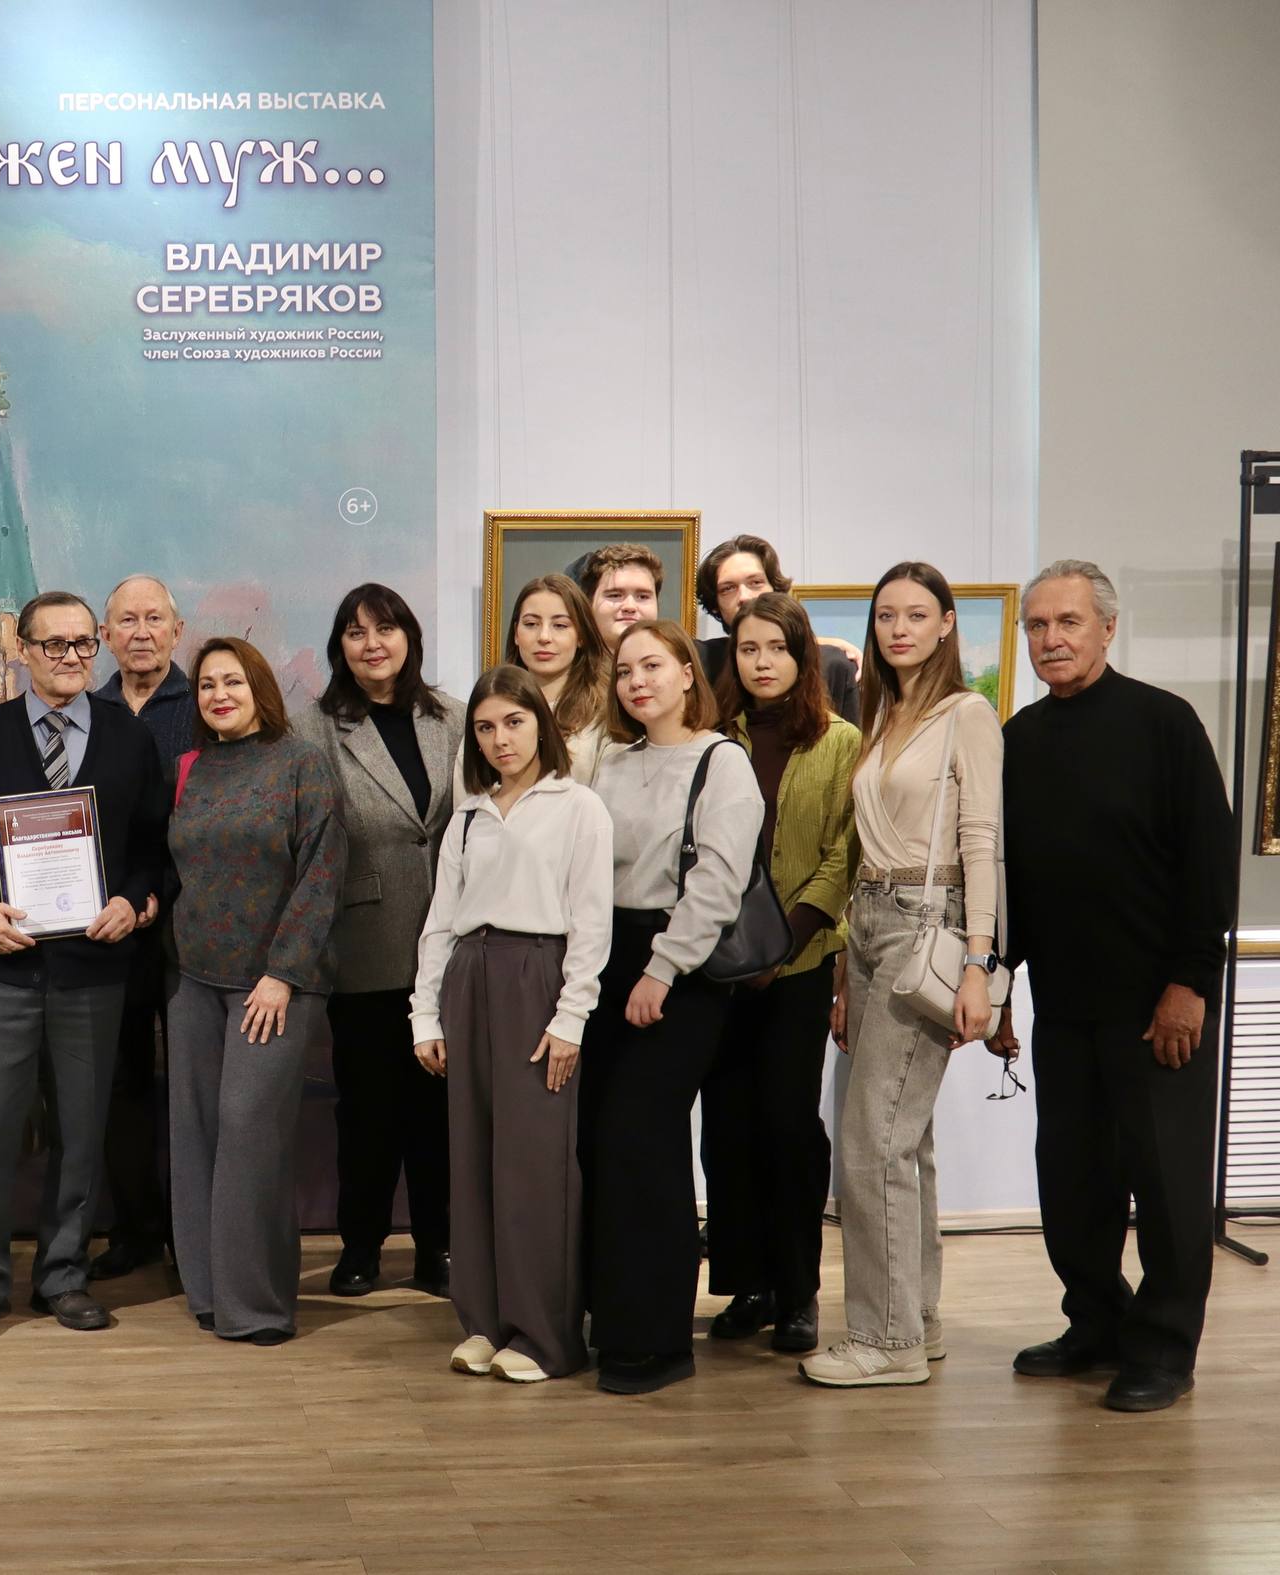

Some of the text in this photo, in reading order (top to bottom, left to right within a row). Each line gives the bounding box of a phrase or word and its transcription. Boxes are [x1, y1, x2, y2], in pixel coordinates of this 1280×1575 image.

[59, 91, 385, 111] ПЕРСОНАЛЬНАЯ ВЫСТАВКА
[166, 243, 382, 275] ВЛАДИМИР
[136, 284, 382, 313] СЕРЕБРЯКОВ
[143, 326, 384, 343] Заслуженный художник России,
[143, 346, 382, 363] член Союза художников России
[347, 498, 371, 514] 6+
